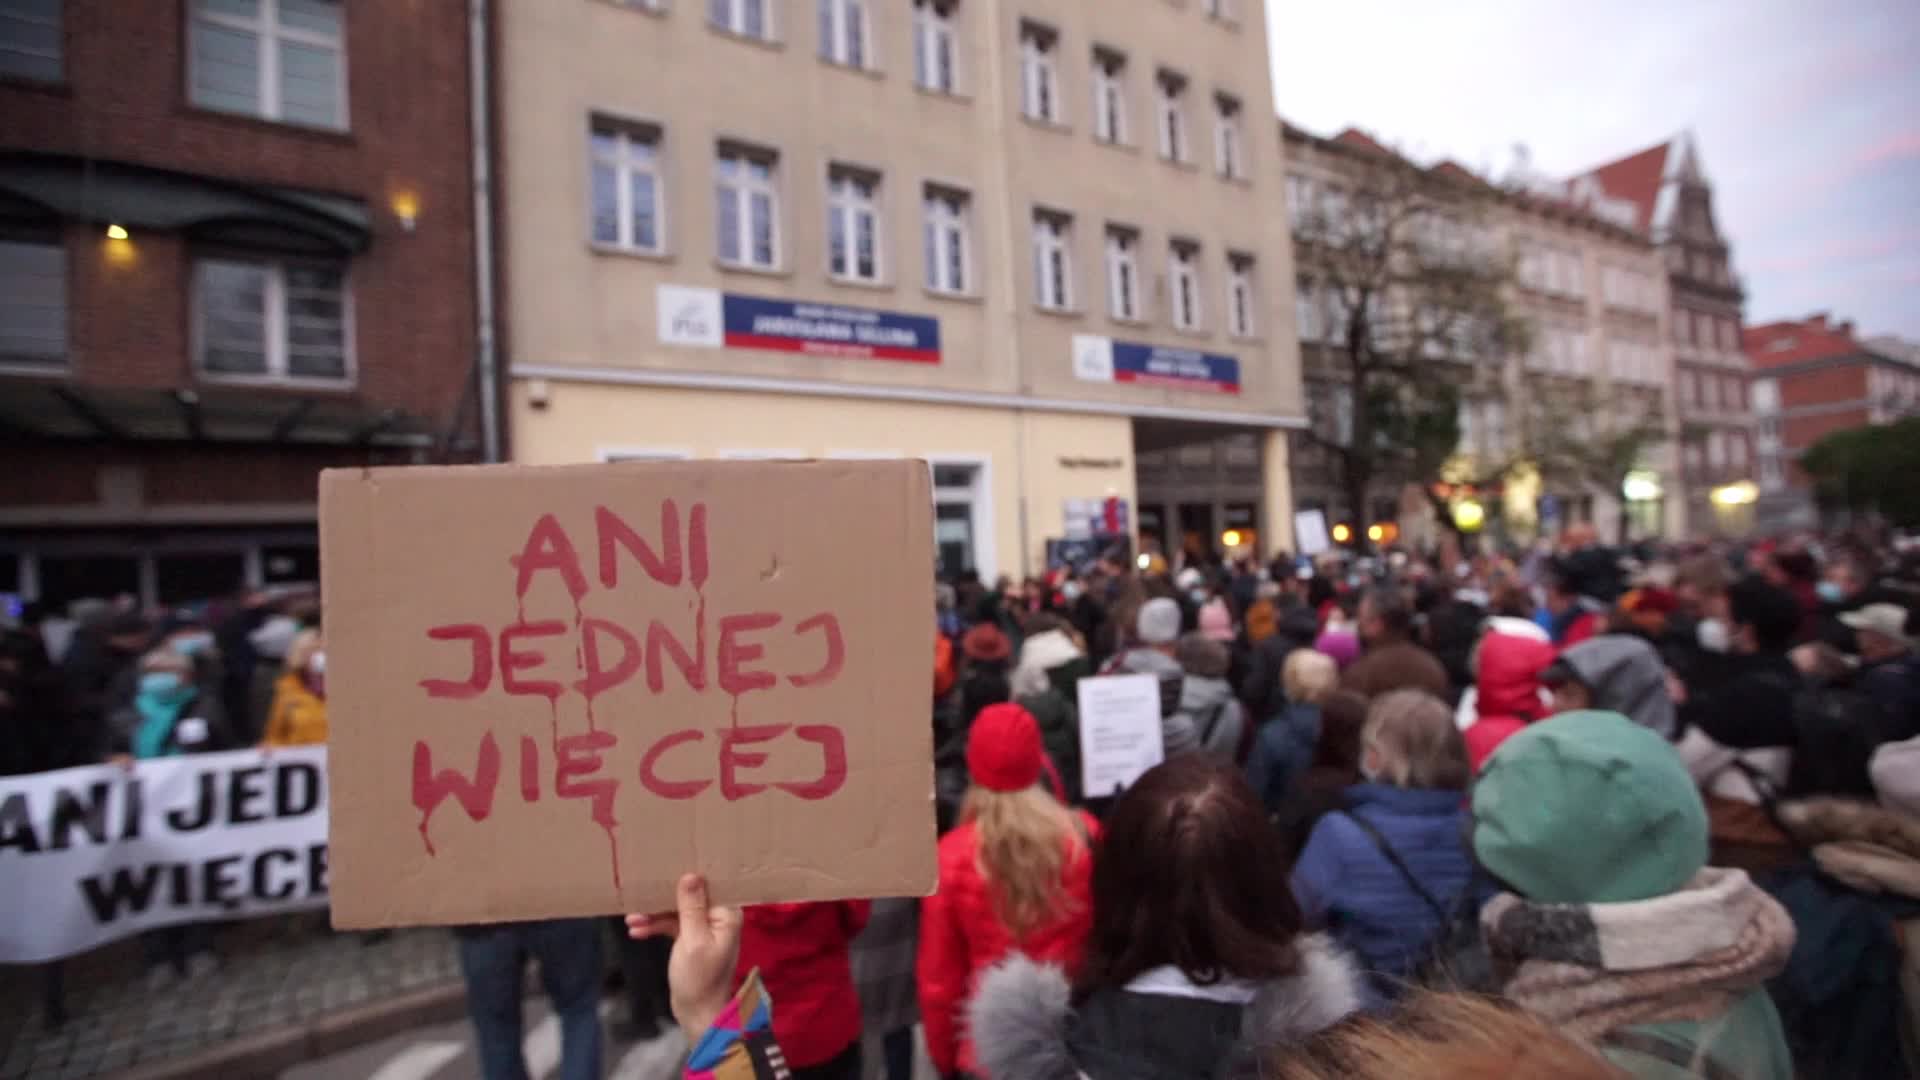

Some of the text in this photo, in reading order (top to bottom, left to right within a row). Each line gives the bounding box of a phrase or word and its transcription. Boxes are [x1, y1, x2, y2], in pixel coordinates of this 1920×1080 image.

[510, 498, 709, 592] ANI
[418, 612, 846, 698] JEDNEJ
[0, 778, 145, 855] ANI
[411, 723, 849, 829] WIĘCEJ
